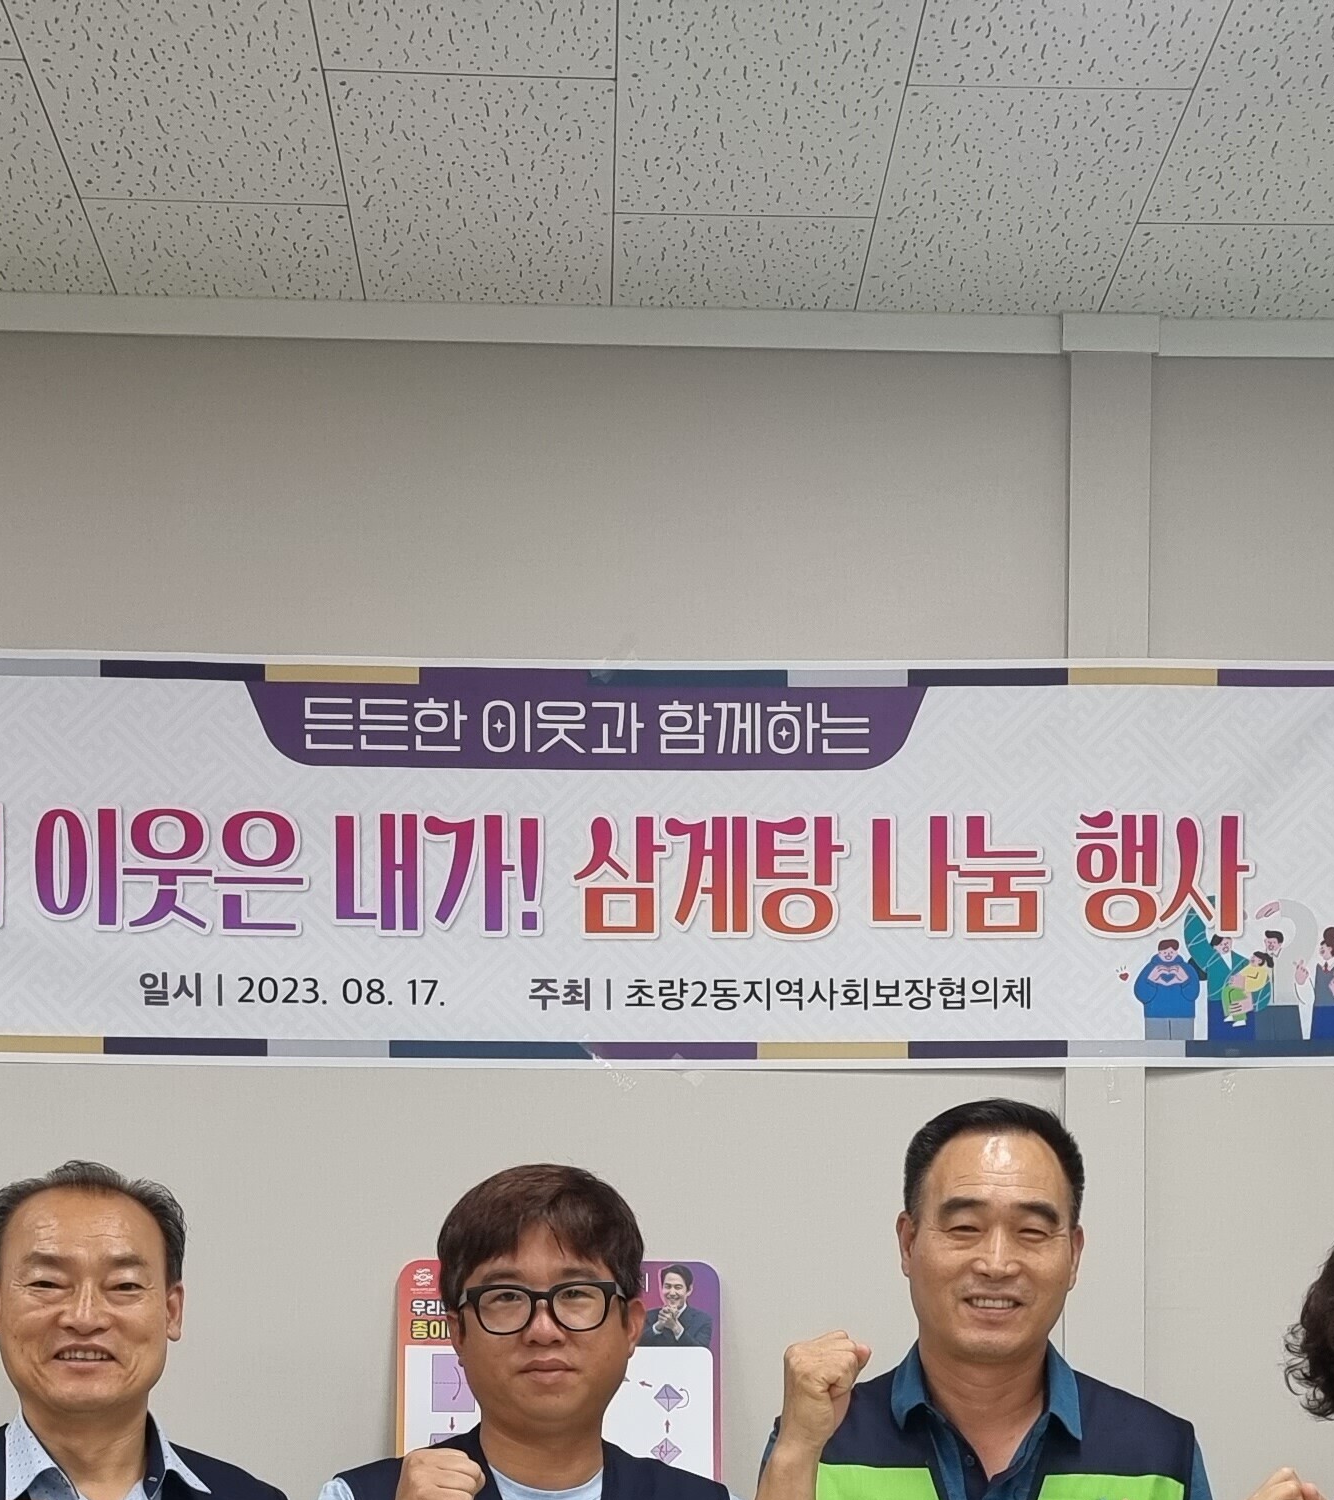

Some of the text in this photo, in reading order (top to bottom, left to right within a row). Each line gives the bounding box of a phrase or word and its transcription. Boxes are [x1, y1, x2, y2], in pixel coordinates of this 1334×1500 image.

[303, 697, 870, 755] 든든한 이웃과 함께하는
[33, 808, 305, 932] 이웃은
[334, 811, 541, 934] 내가!
[573, 814, 846, 934] 삼계탕
[870, 815, 1047, 934] 나눔
[1074, 810, 1250, 934] 행사
[139, 972, 446, 1006] 일시 2023. 08. 17.
[528, 976, 1032, 1012] 주최 초량2동지역사회보장협의체
[411, 1320, 451, 1339] 종이
